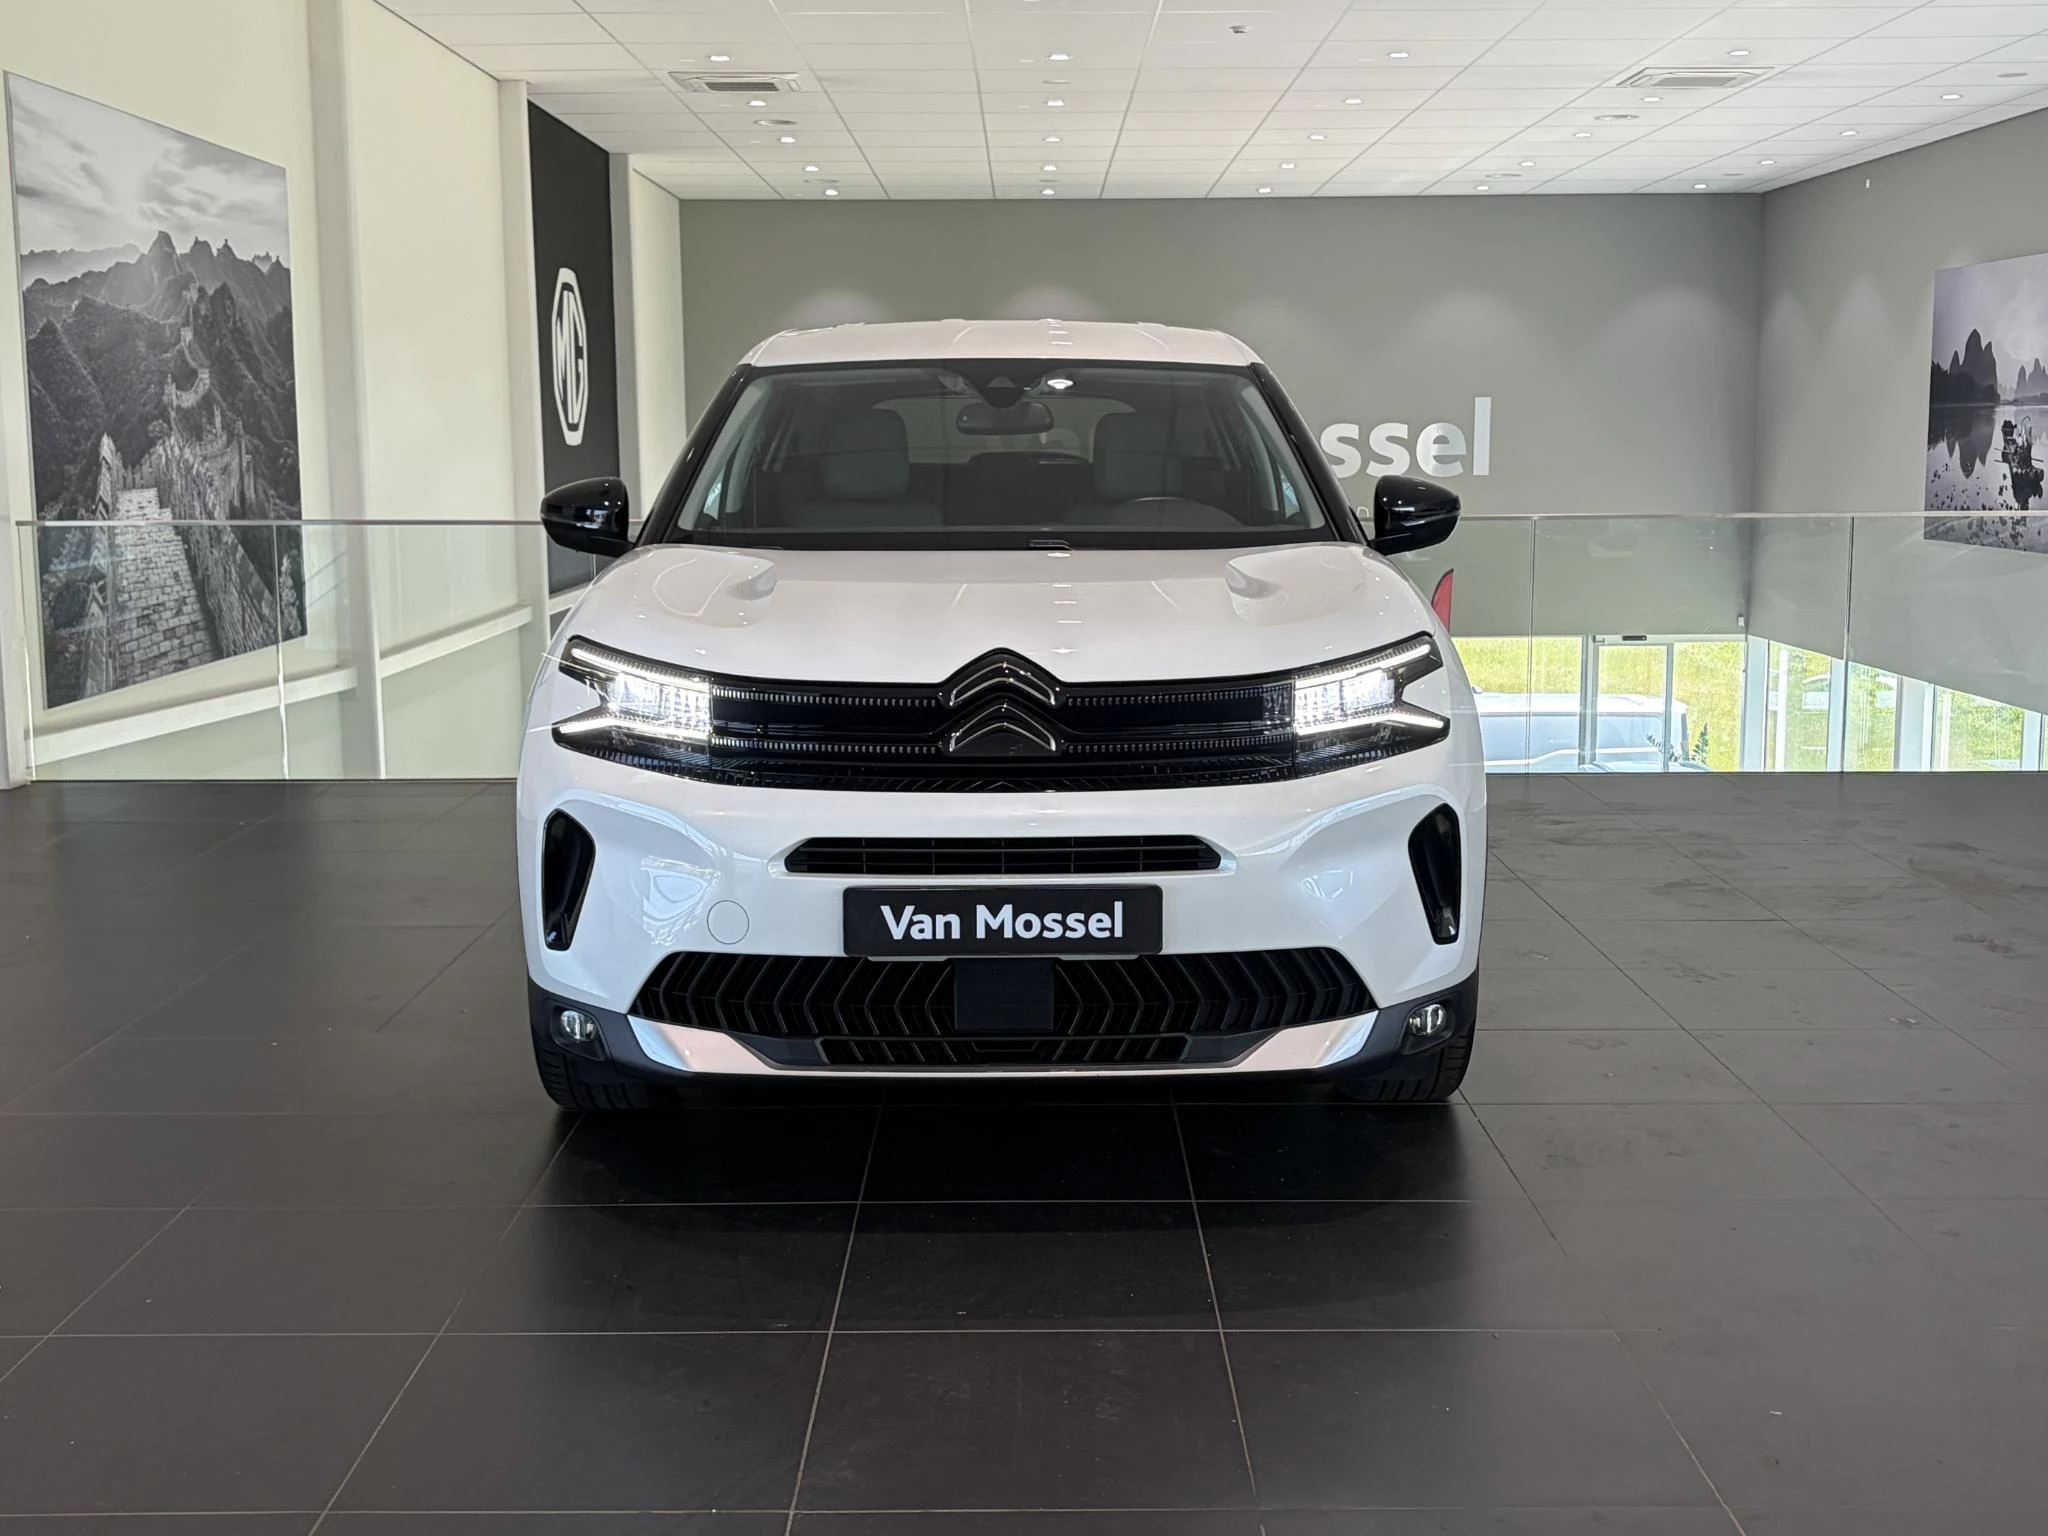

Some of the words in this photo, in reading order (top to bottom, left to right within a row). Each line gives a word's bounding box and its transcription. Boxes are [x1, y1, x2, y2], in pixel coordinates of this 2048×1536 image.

[556, 289, 584, 425] MG
[880, 904, 961, 940] Van
[975, 900, 1124, 940] Mossel
